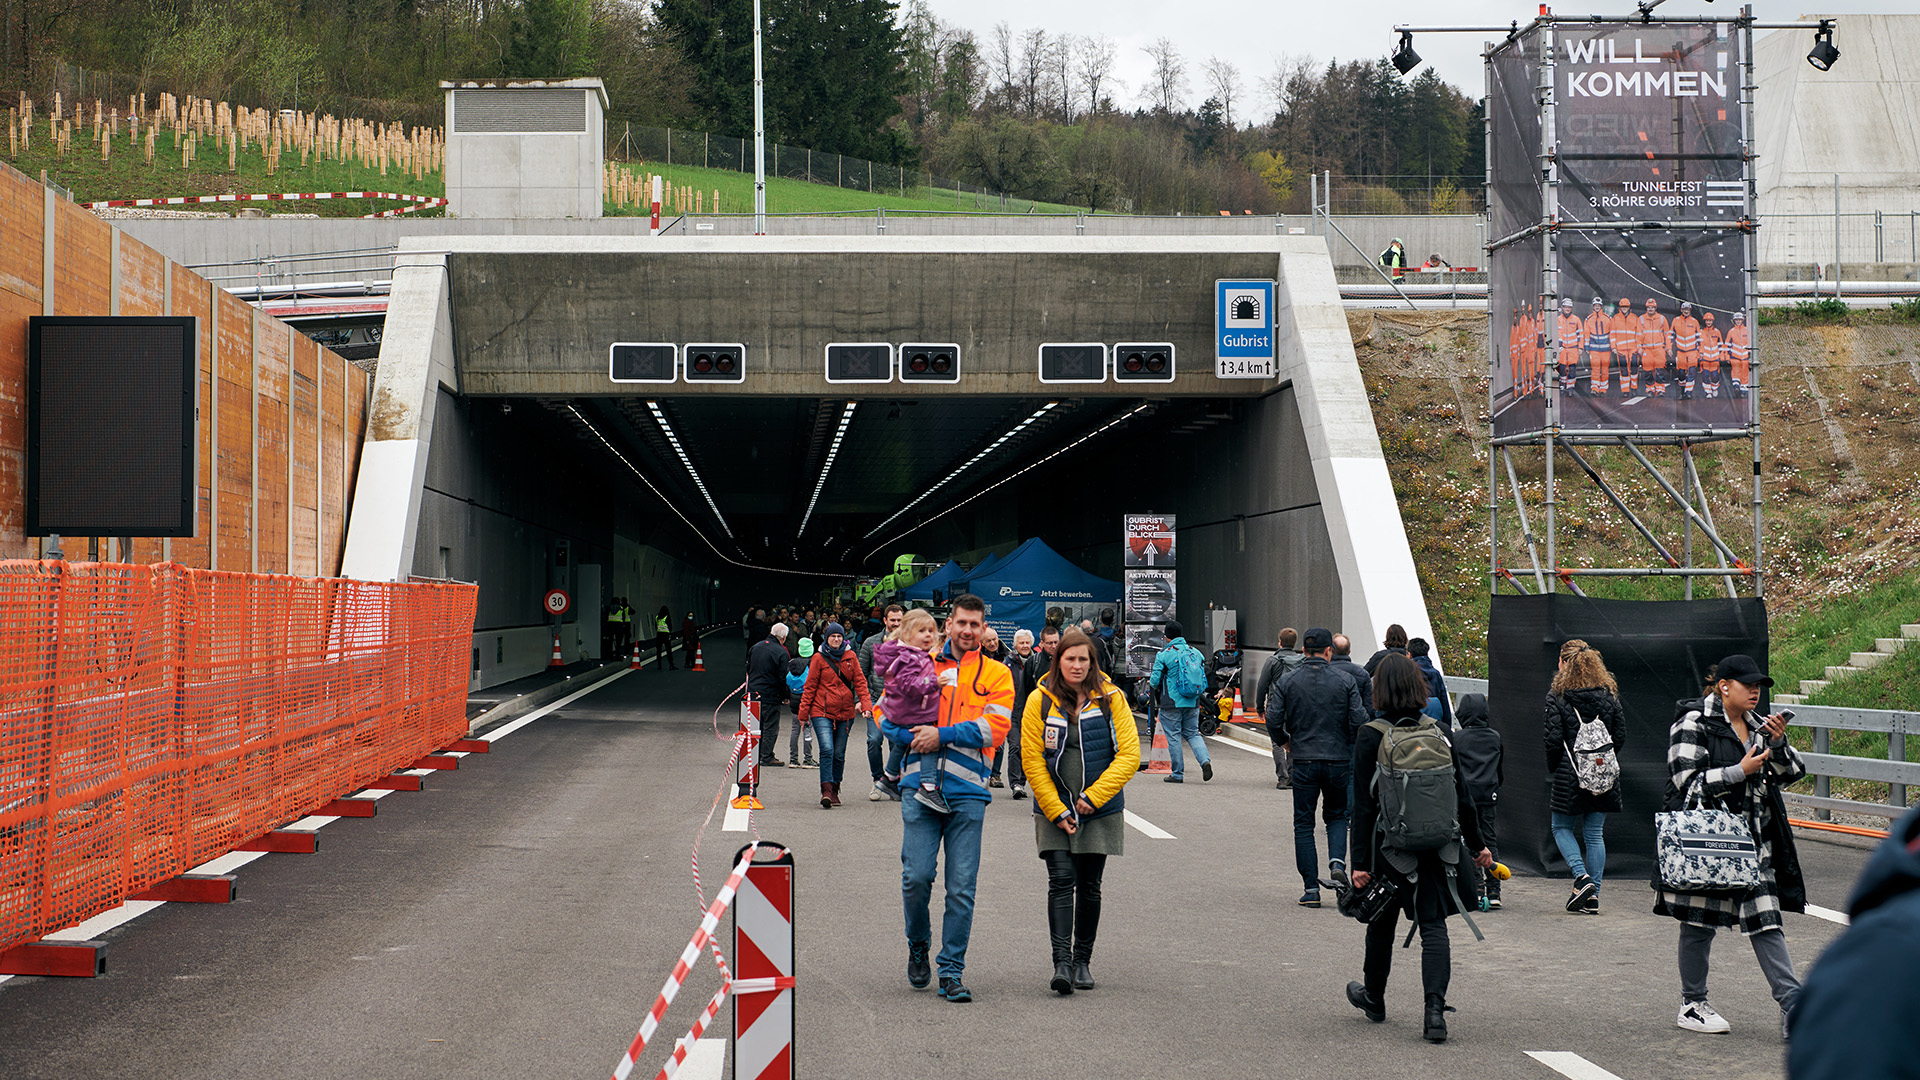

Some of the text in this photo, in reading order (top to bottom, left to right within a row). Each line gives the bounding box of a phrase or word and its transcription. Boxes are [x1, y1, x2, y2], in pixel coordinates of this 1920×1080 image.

[1565, 38, 1660, 64] WILL
[1568, 71, 1725, 97] KOMMEN
[1622, 181, 1702, 192] TUNNELFEST
[1589, 194, 1702, 208] 3. RÖHRE GUBRIST
[1223, 334, 1268, 347] Gubrist
[1228, 361, 1263, 375] 3,4 km
[1040, 589, 1057, 598] Jetzt
[1059, 590, 1093, 598] bewerben.
[551, 597, 563, 607] 30
[1704, 841, 1740, 850] FOREVER LOVE
